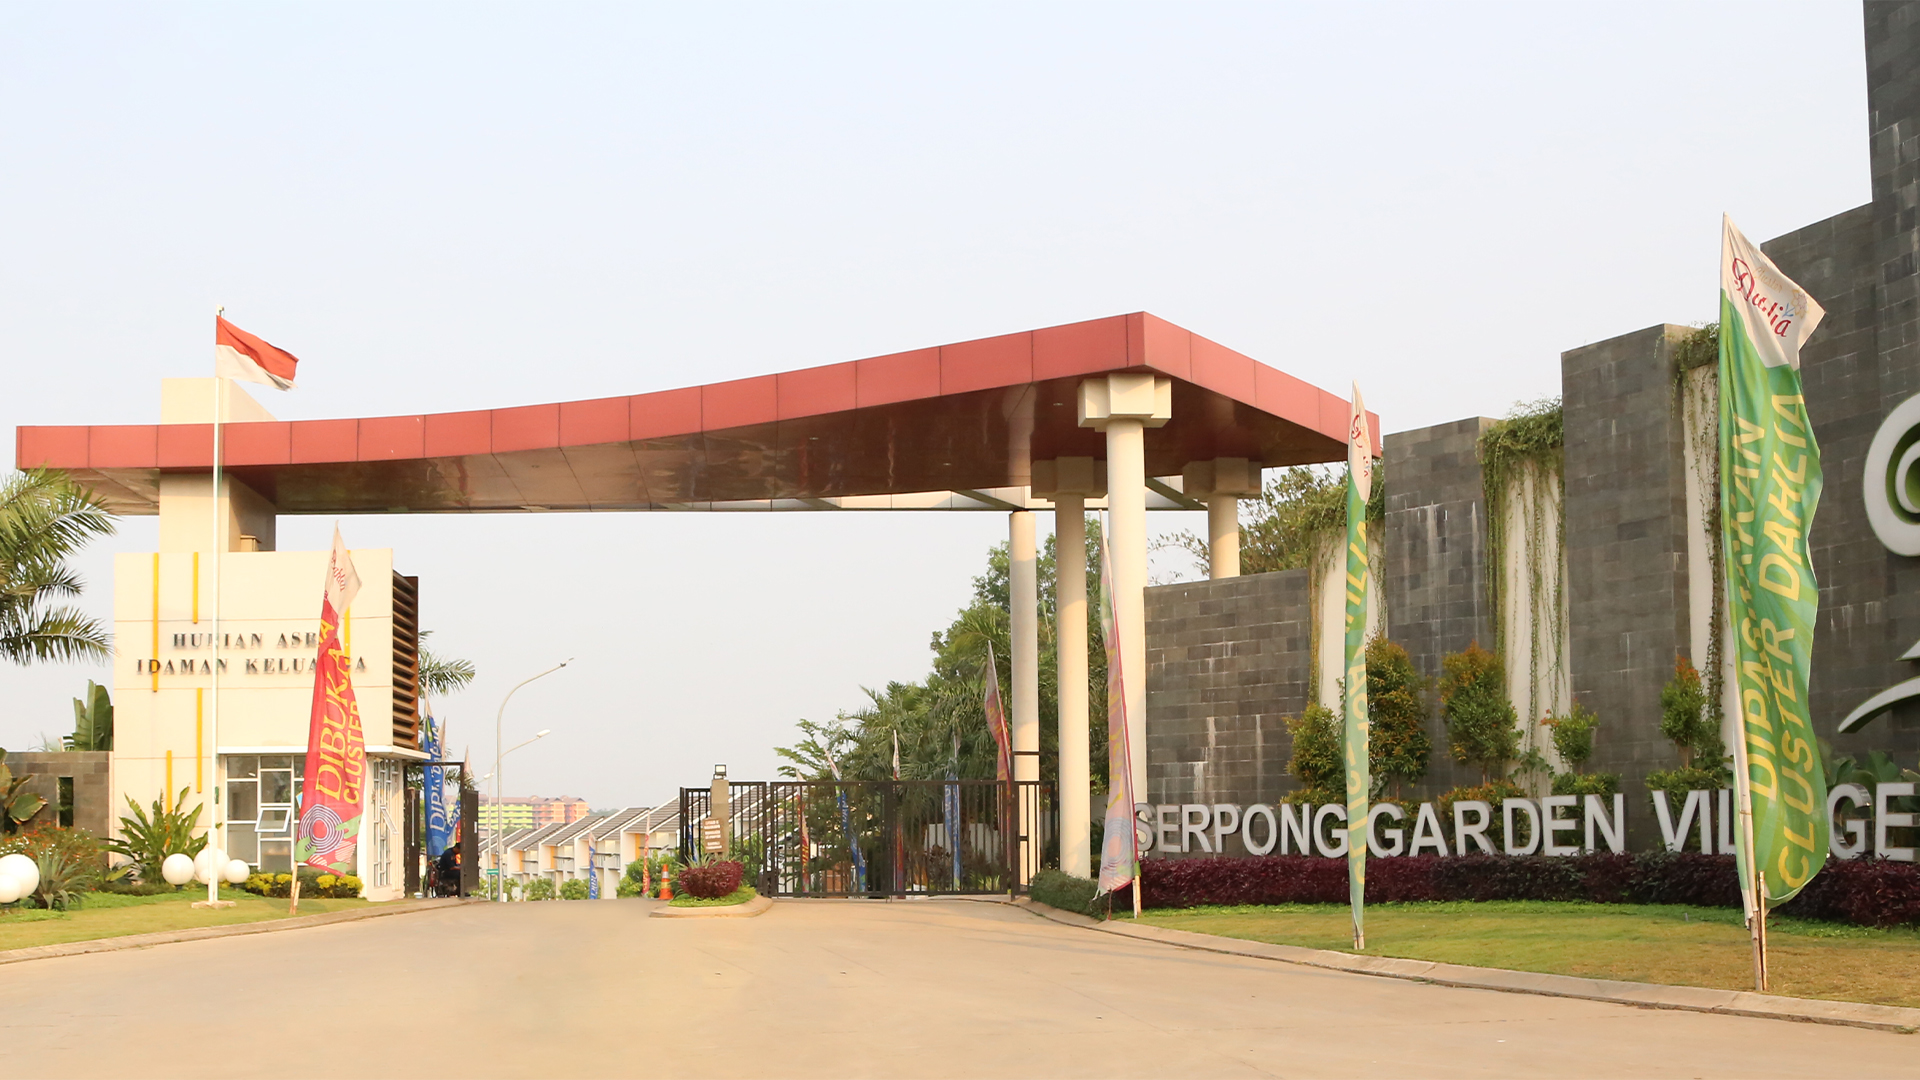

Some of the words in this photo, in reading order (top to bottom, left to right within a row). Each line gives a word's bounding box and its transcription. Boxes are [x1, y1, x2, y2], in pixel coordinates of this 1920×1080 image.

[1758, 394, 1808, 602] DAHLIA
[136, 658, 228, 675] IDAMAN
[276, 632, 319, 649] ASR
[1760, 618, 1815, 889] CLUSTER
[1135, 803, 1349, 859] SERPONG
[1366, 793, 1626, 859] GARDEN
[1651, 782, 1919, 862] VILGE
